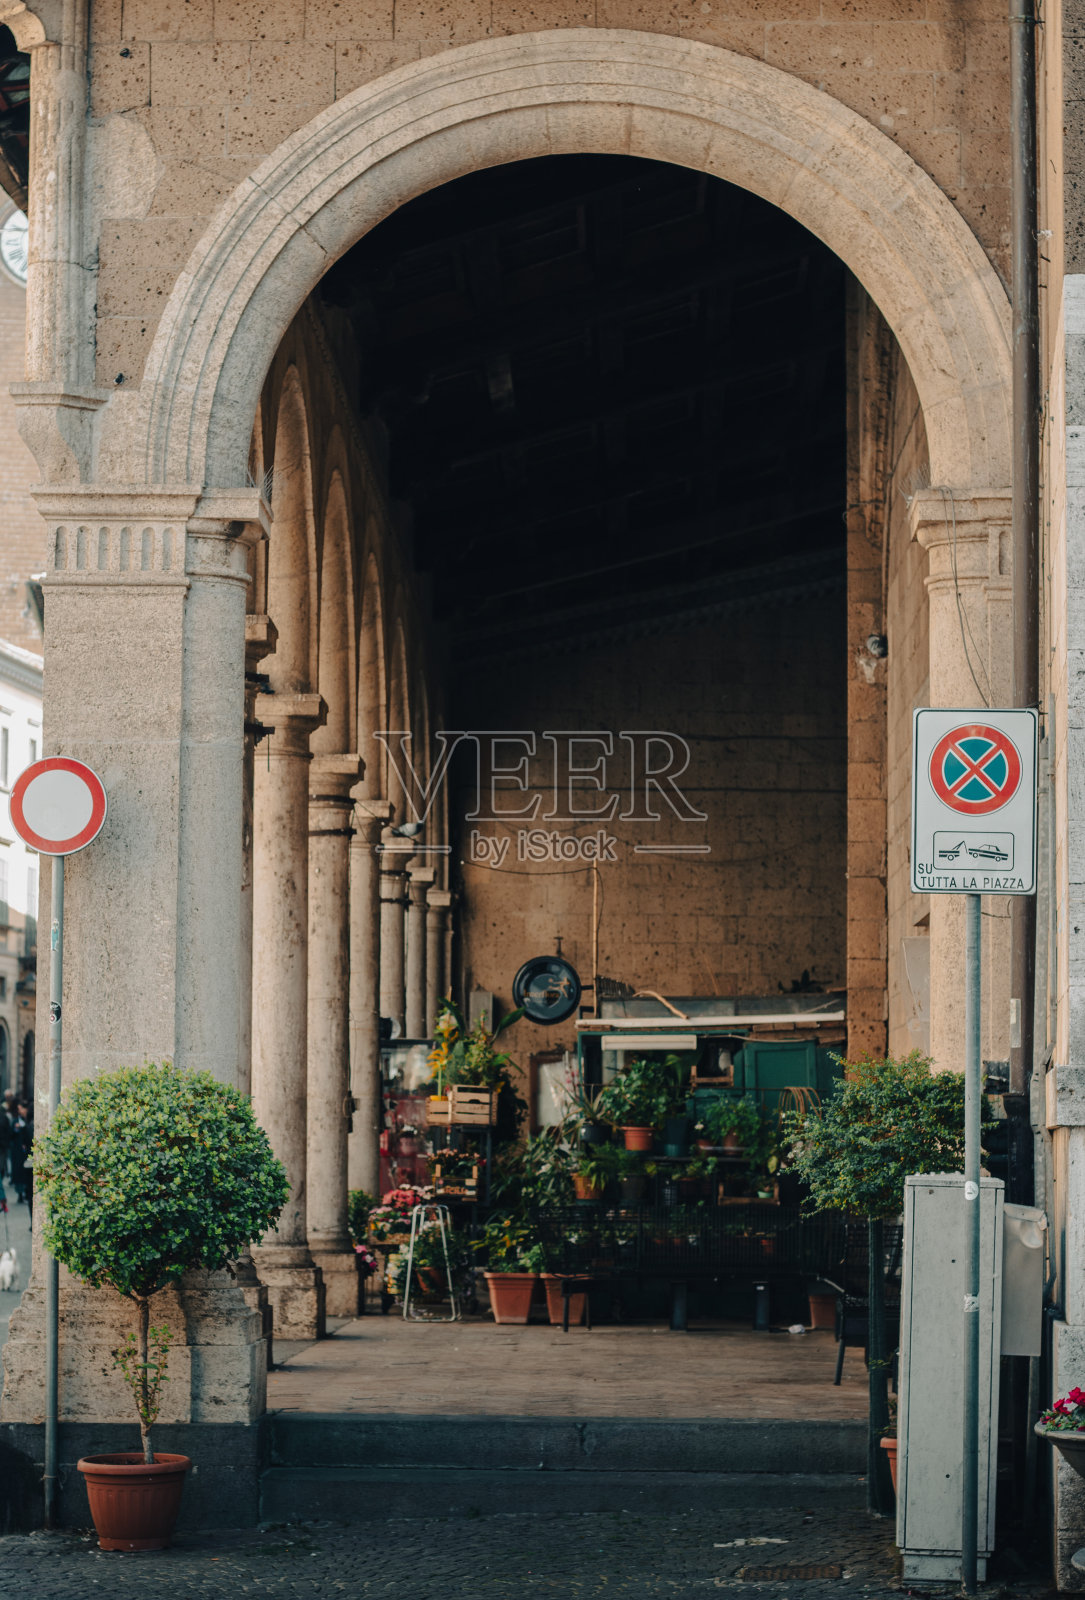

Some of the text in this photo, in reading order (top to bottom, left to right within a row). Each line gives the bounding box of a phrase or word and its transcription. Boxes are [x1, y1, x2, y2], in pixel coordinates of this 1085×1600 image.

[917, 863, 933, 875] SU
[920, 876, 1025, 889] TUTTA LA PIAZZA
